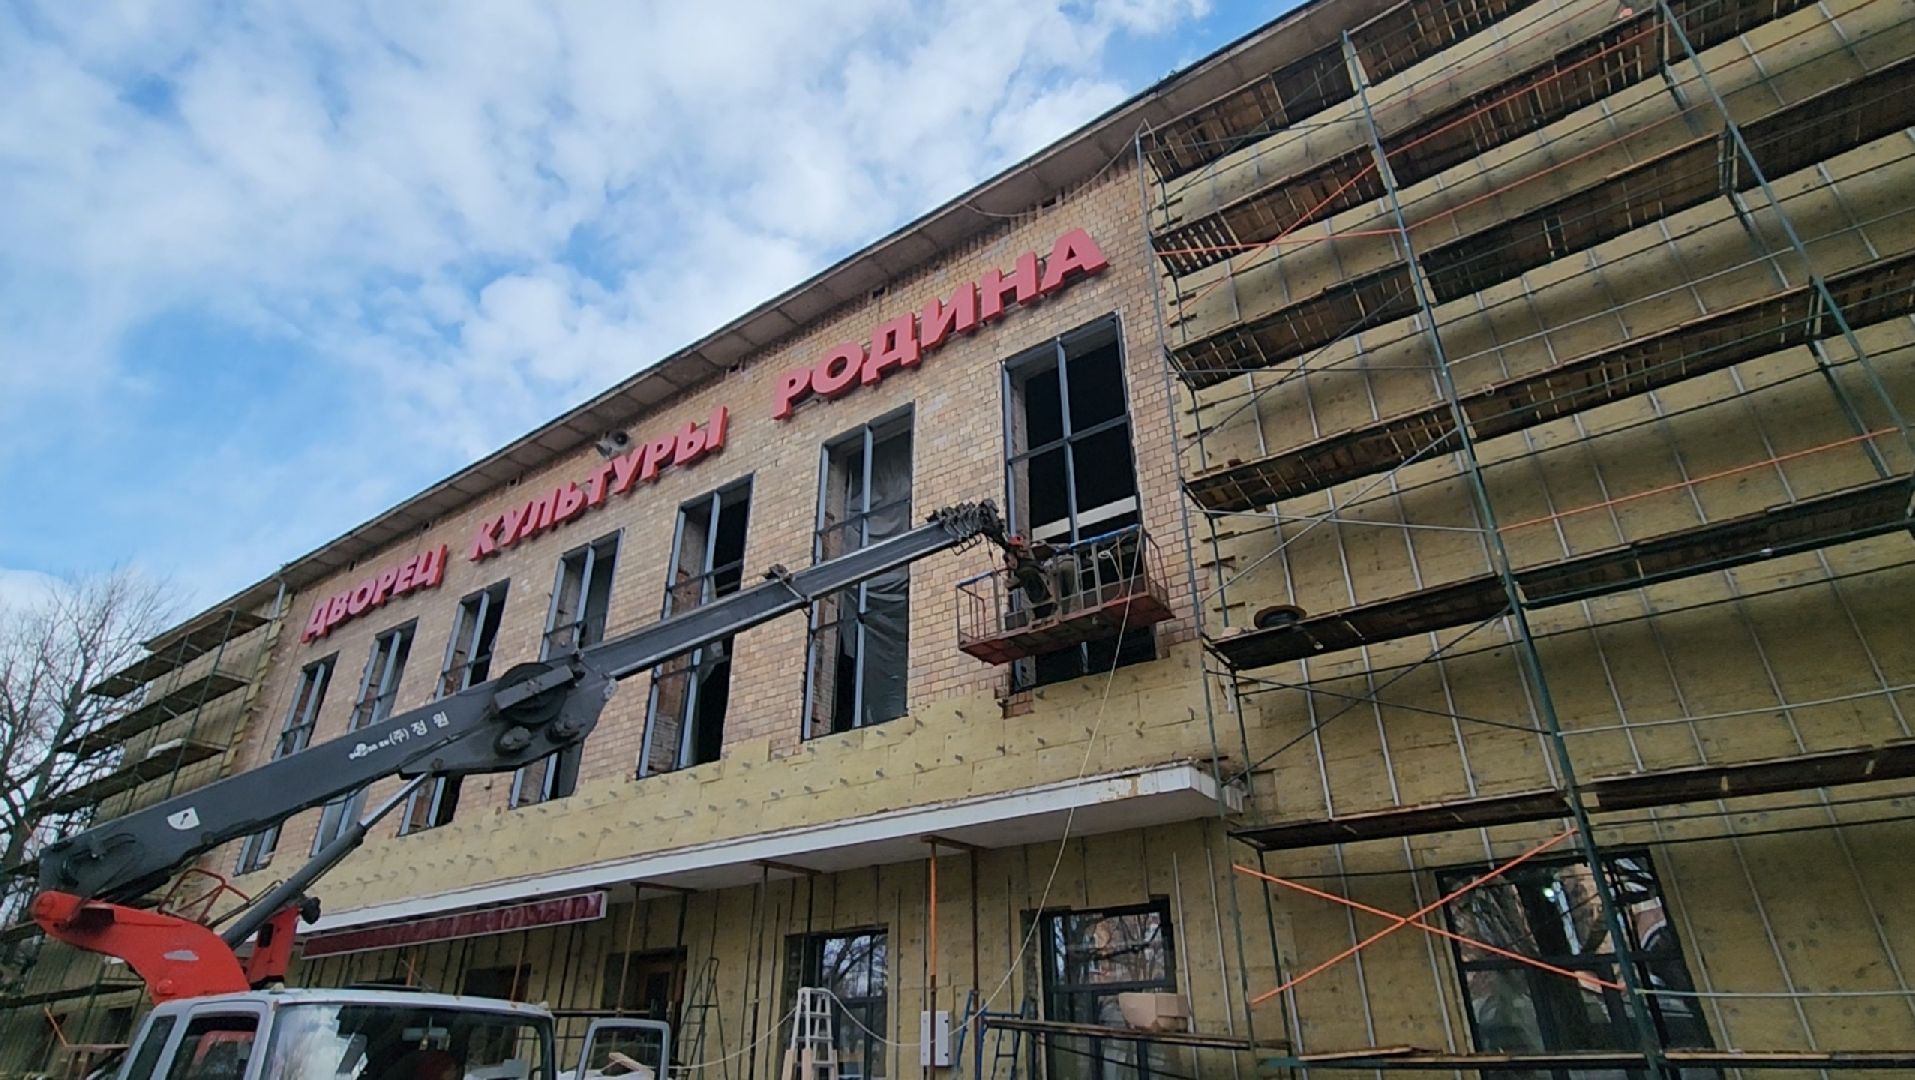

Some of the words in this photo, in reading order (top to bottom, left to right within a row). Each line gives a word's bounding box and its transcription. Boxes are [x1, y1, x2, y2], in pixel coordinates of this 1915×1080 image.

[301, 543, 448, 644] ДВОРЕЦ
[468, 406, 728, 562] КУЛЬТУРЫ
[773, 227, 1109, 421] РОДИНА
